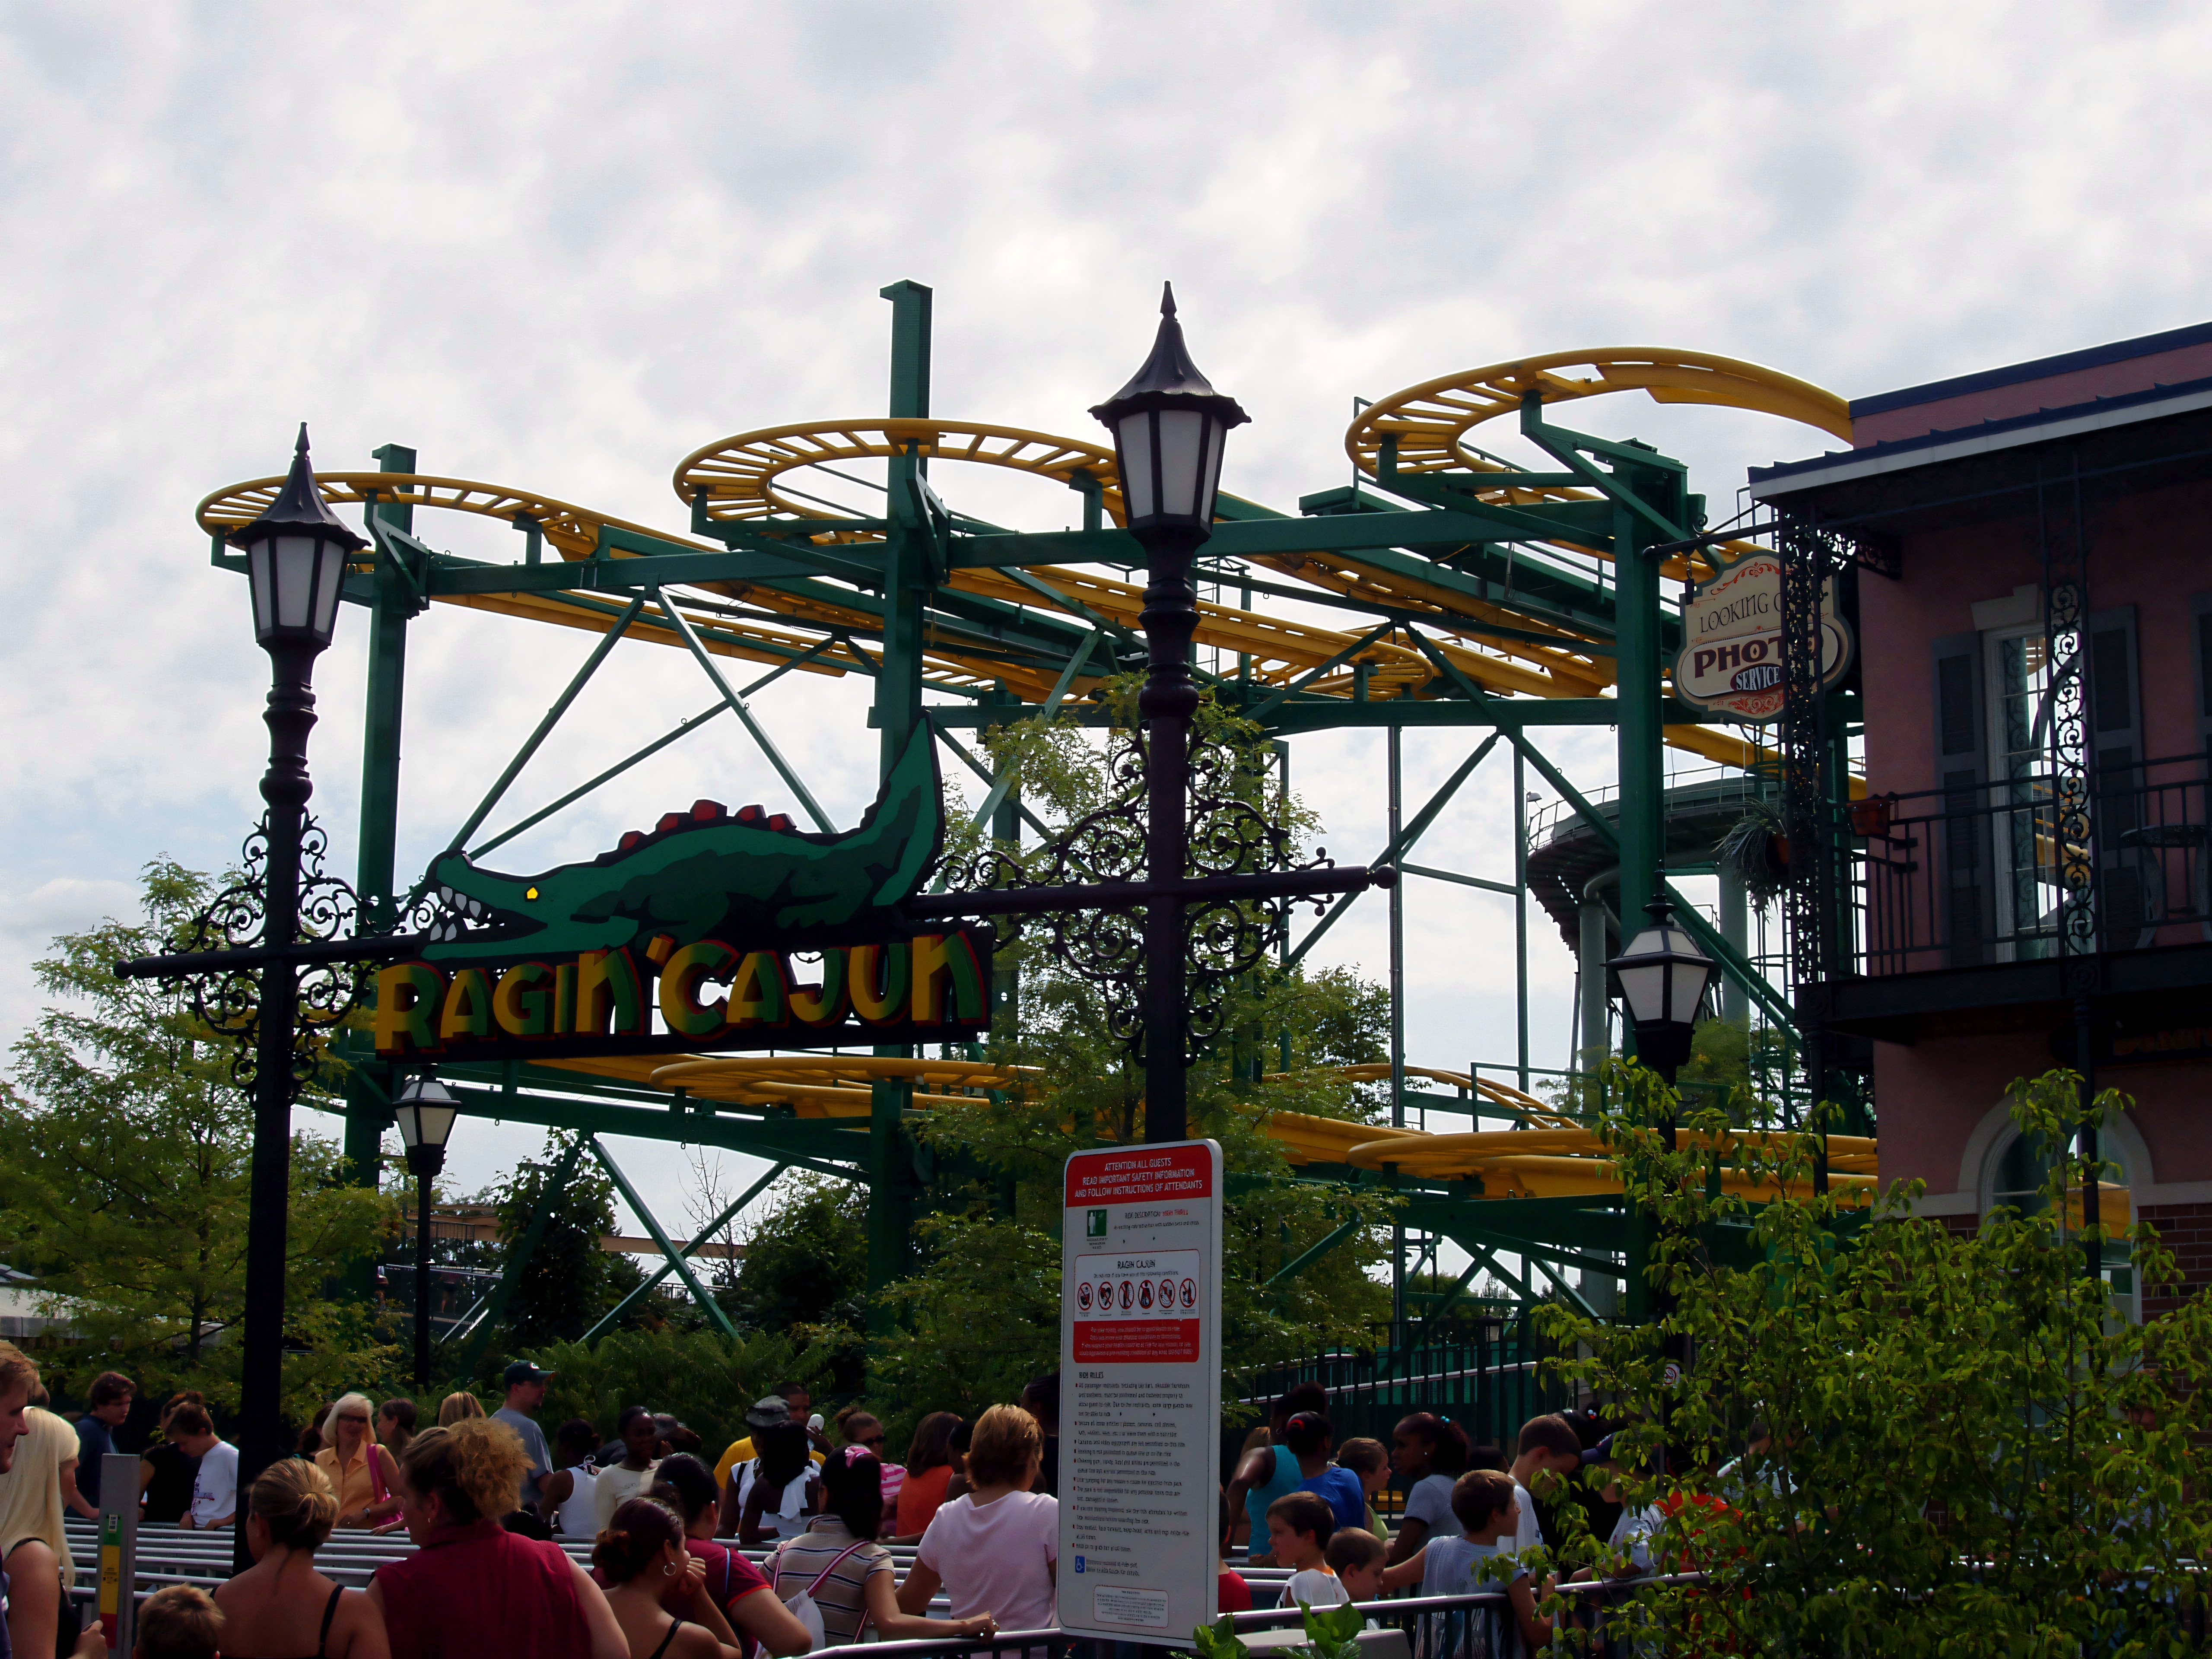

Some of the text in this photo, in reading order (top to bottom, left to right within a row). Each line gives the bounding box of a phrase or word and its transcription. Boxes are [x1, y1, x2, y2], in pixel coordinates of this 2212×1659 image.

[1699, 592, 1768, 633] LOOKING
[1694, 632, 1812, 679] PHOT
[1735, 666, 1780, 691] SERVICE
[658, 930, 987, 1042] CAJUN
[1099, 1173, 1131, 1184] IMPORTANT
[1131, 1171, 1154, 1182] SAFETY
[1154, 1169, 1195, 1180] INFORMATION
[1105, 1157, 1171, 1171] ATTENTION ALL GUESTS
[1075, 1180, 1202, 1198] AND FOLLOW INSTRUCTIONS OF ATTENDANTS
